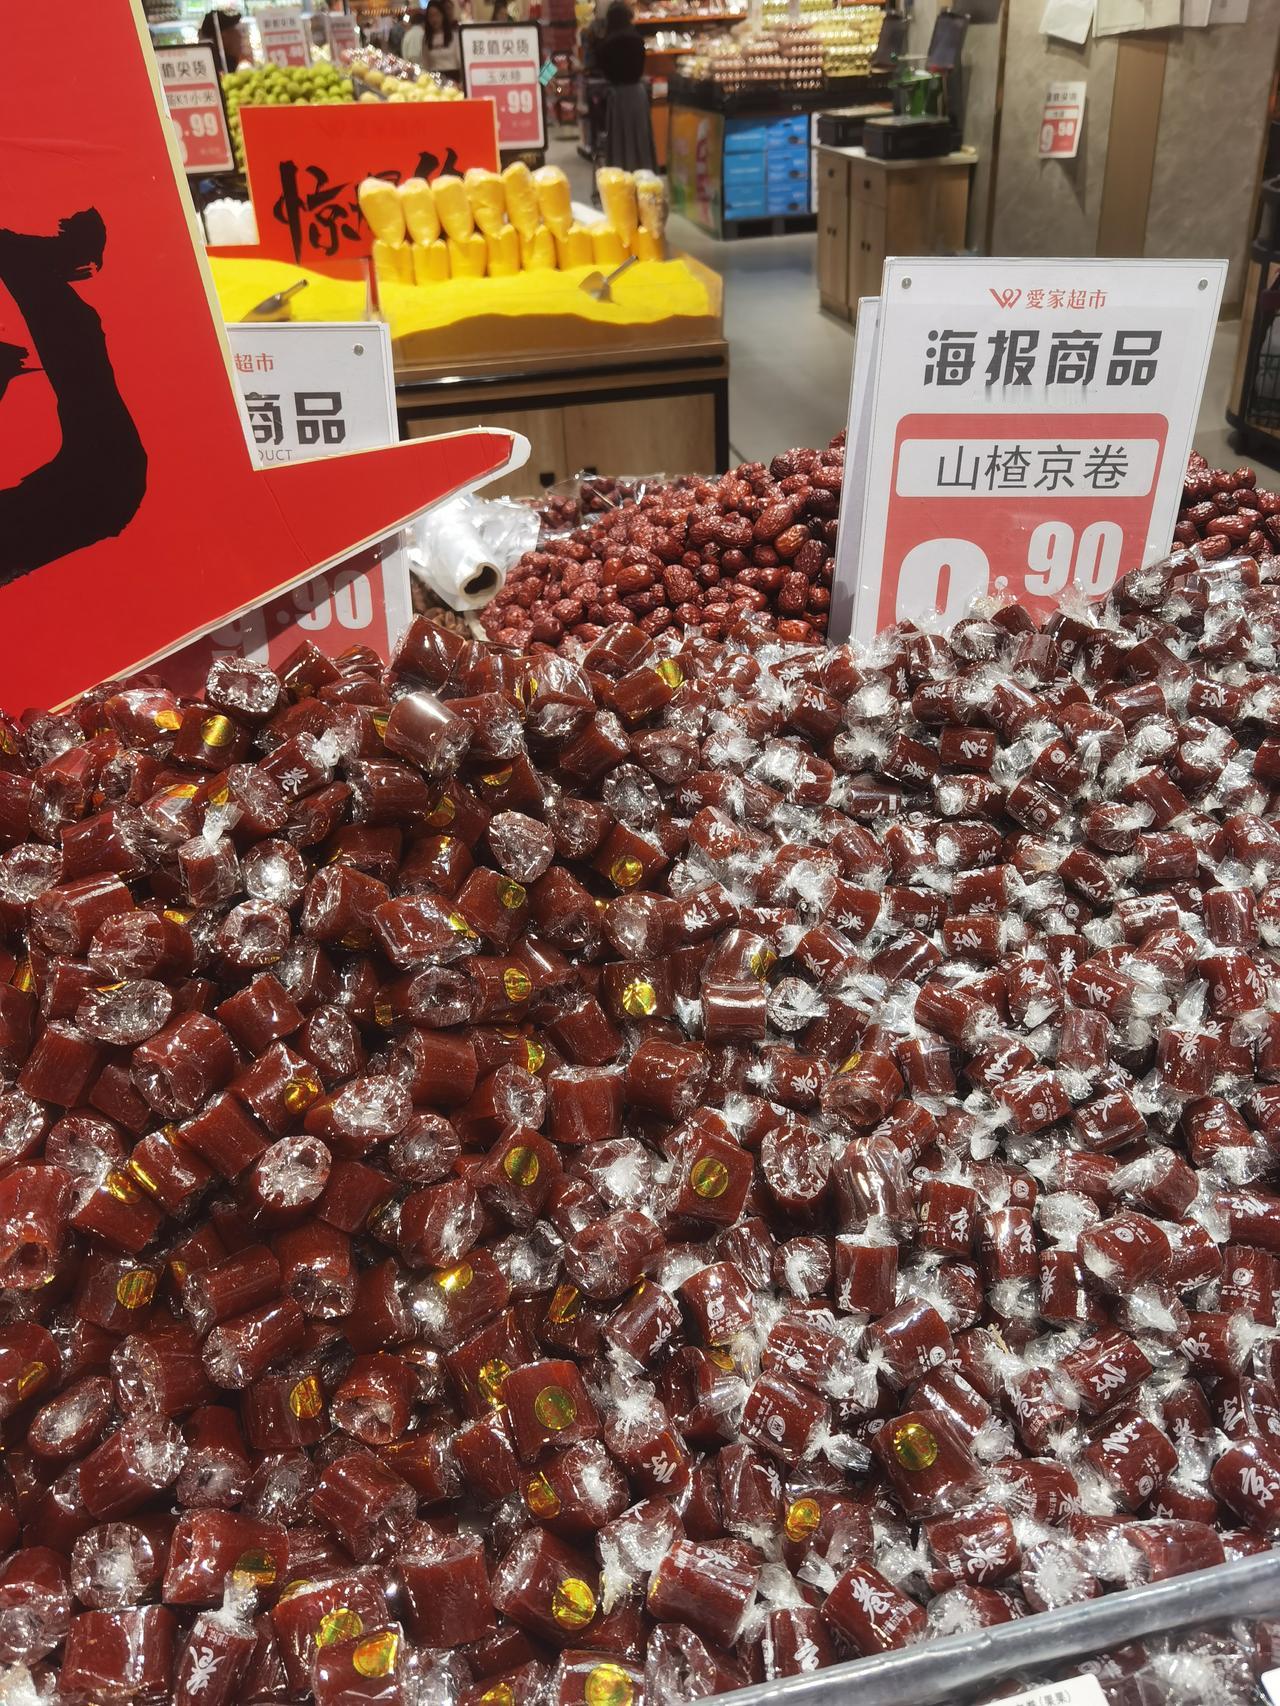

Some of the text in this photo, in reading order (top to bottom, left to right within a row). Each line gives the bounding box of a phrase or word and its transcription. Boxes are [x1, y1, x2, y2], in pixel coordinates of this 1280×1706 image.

[1025, 288, 1108, 310] 愛家超市
[234, 353, 274, 373] 超市
[923, 329, 1162, 386] 海报商品
[244, 392, 346, 445] 商品
[936, 444, 1129, 491] 山楂京卷
[949, 1206, 970, 1243] 京
[1014, 1218, 1036, 1255] 京
[850, 1576, 895, 1625] 卷
